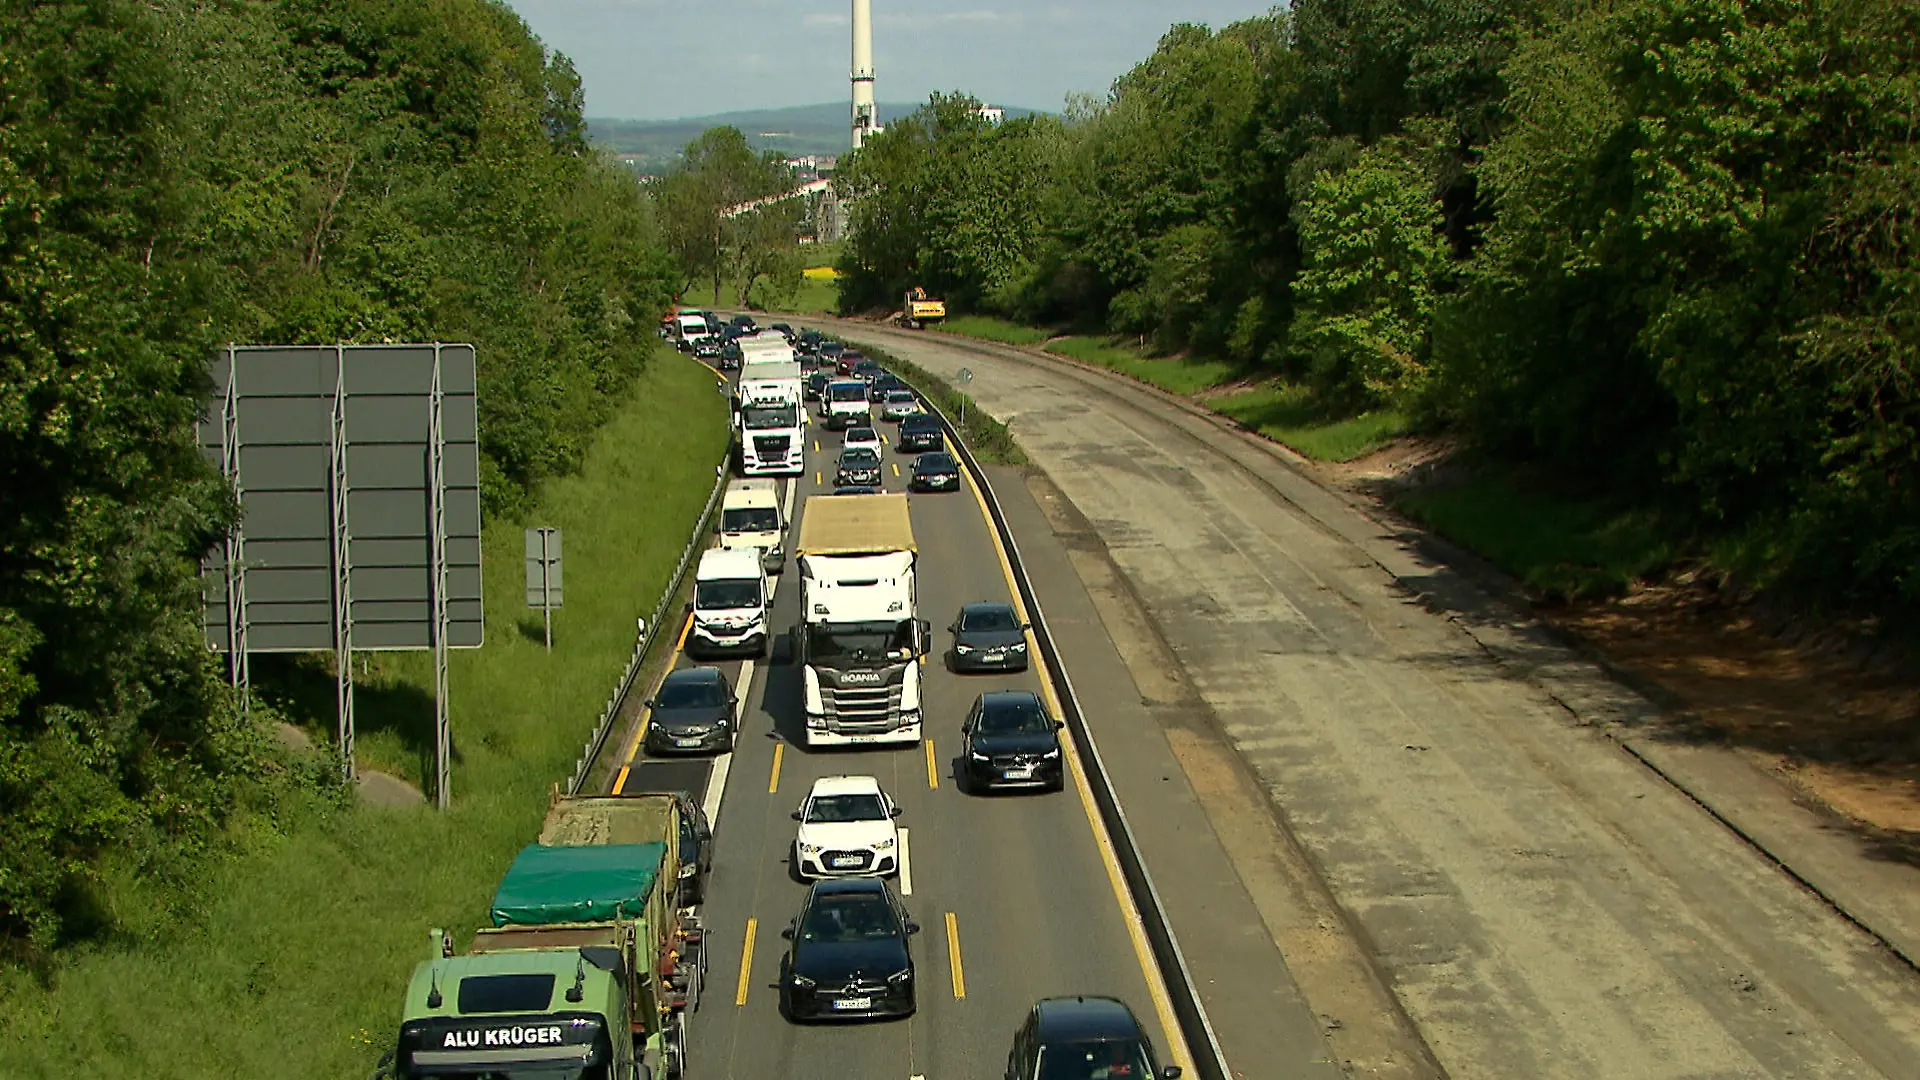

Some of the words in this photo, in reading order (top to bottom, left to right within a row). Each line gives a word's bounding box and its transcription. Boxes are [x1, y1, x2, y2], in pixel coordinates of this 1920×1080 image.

[840, 673, 880, 683] SCANIA
[443, 1031, 480, 1047] ALU
[485, 1027, 562, 1046] KRÜGER
